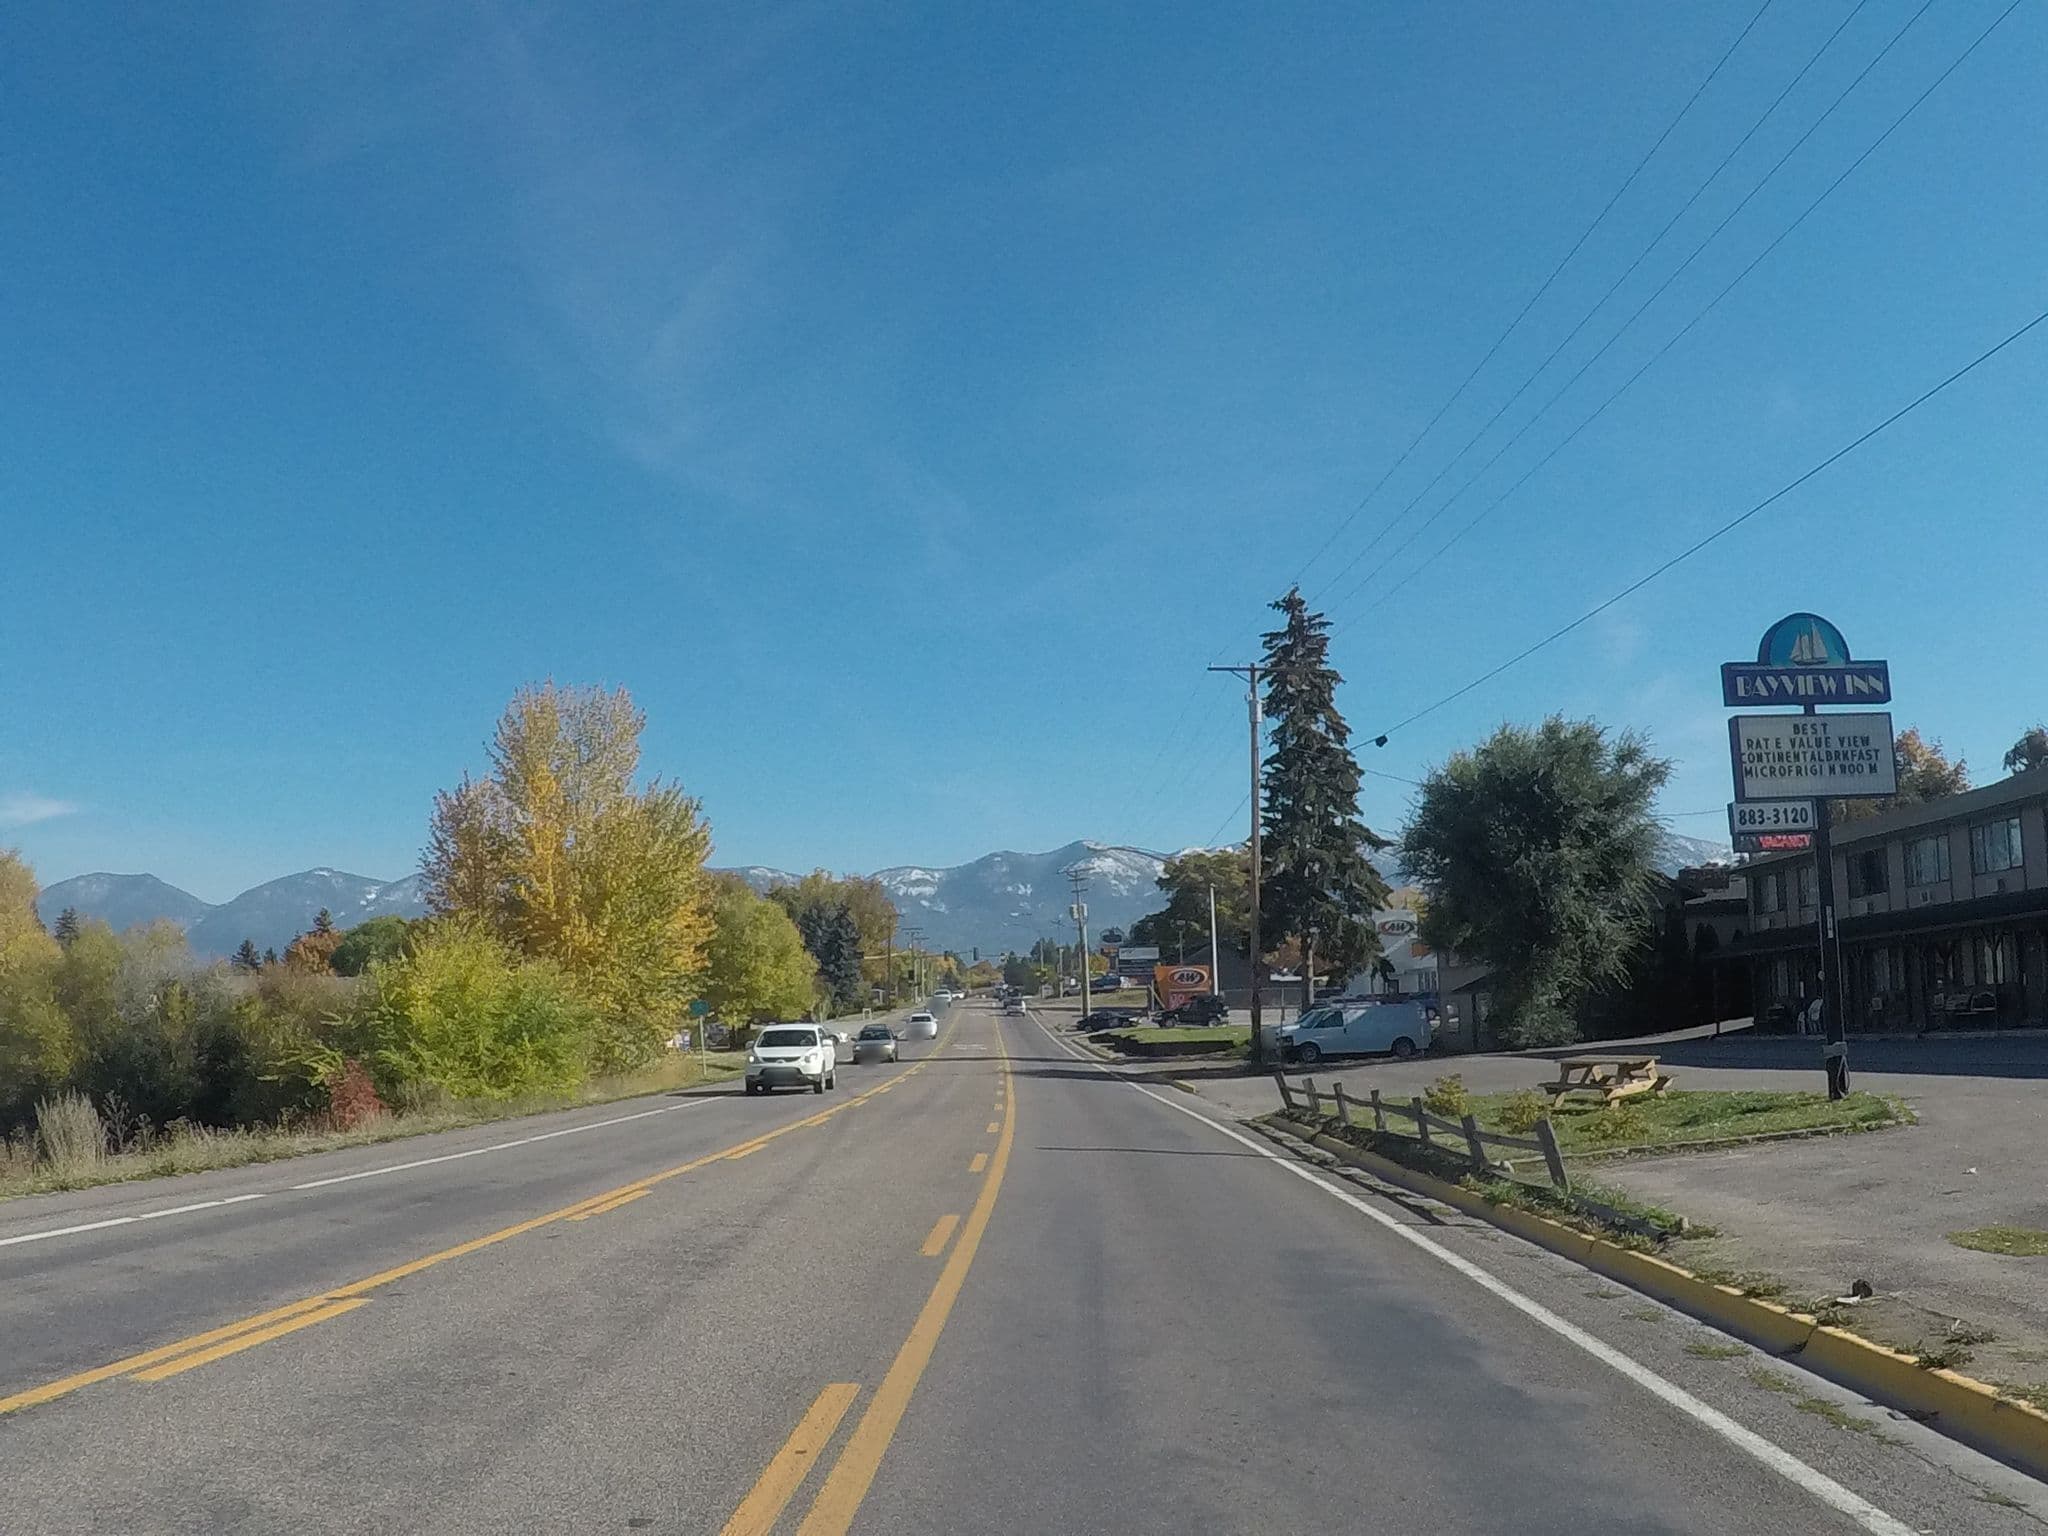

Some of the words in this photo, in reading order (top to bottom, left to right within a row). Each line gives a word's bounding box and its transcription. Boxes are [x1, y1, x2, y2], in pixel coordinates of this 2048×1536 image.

[1736, 674, 1837, 697] BAYVIEW
[1844, 674, 1884, 695] INN
[1793, 722, 1828, 735] BEST
[1746, 737, 1782, 750] RATE
[1790, 736, 1831, 749] VALUE
[1838, 735, 1870, 747] VIEW
[1739, 807, 1809, 826] 883-3120
